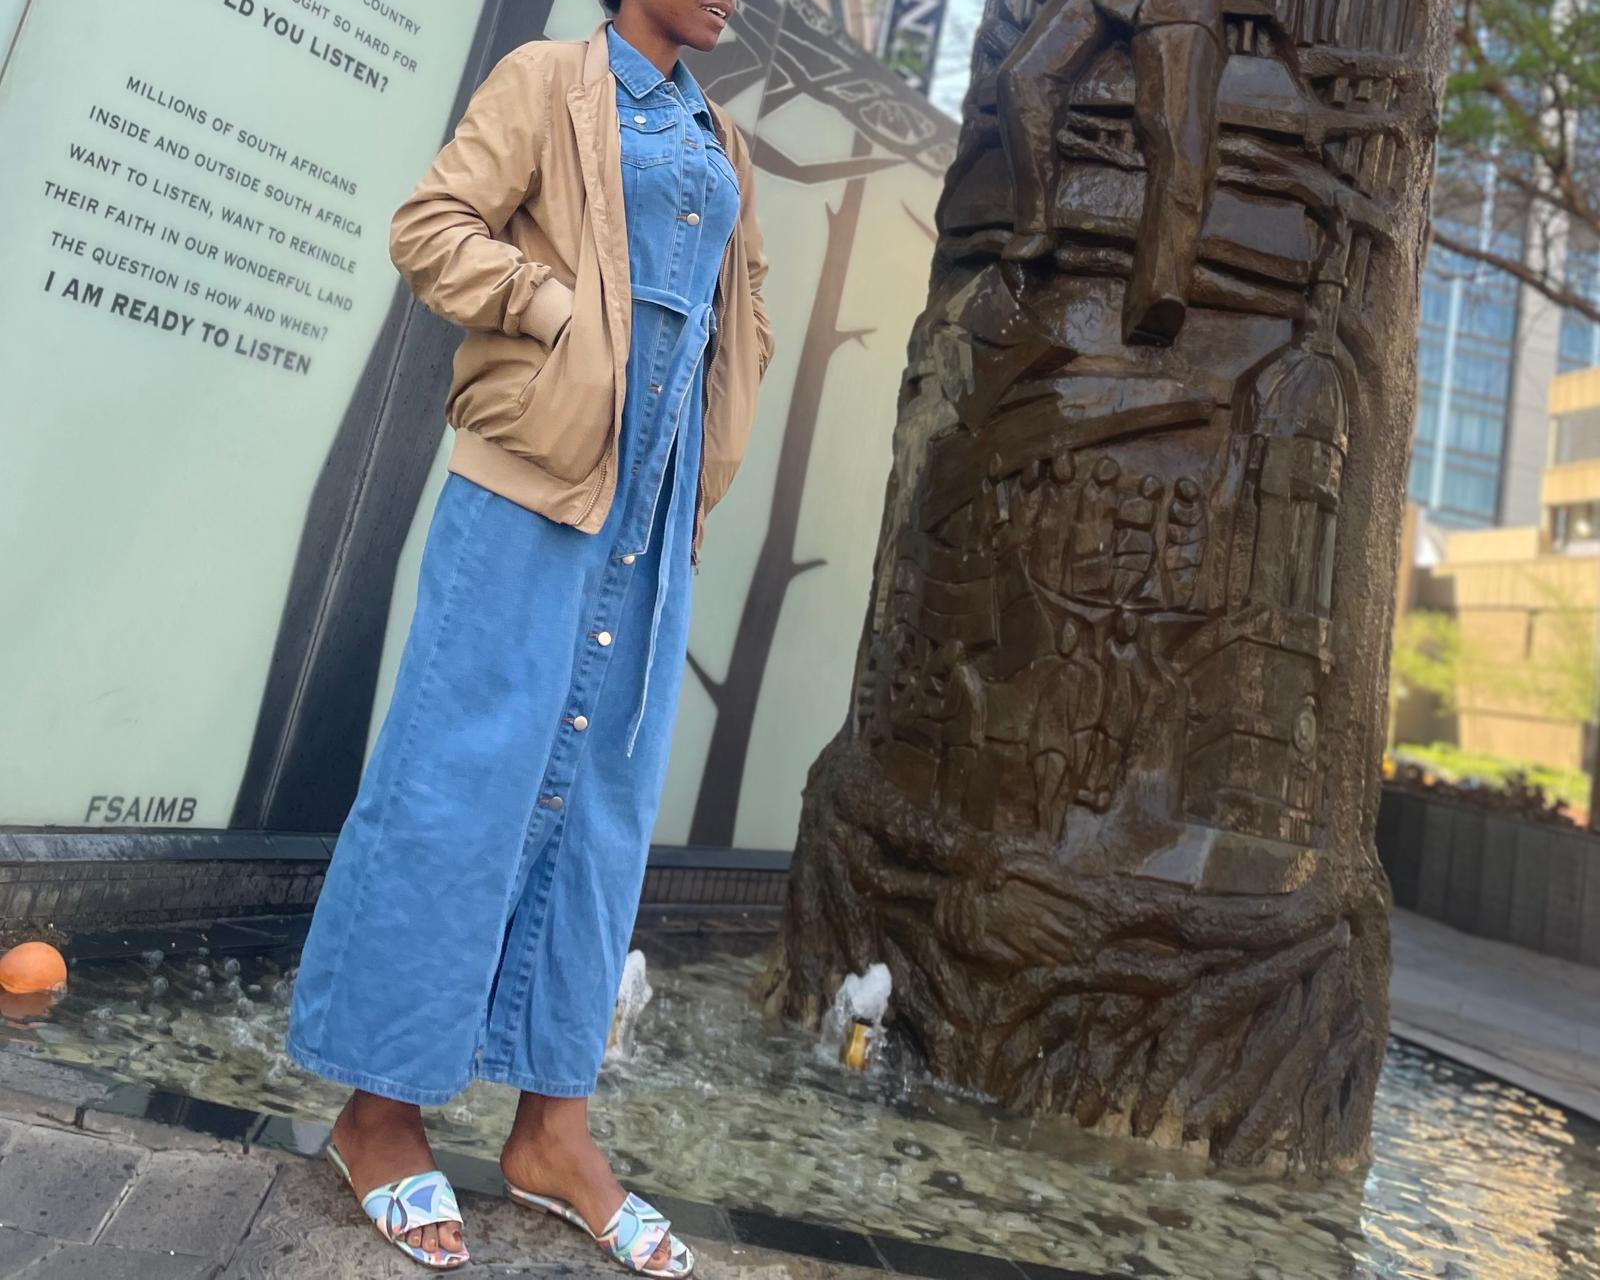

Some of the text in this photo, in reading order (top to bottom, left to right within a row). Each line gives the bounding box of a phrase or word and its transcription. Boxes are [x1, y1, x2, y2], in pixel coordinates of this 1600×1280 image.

[262, 7, 304, 44] YOU
[309, 36, 389, 93] LISTEN?
[332, 14, 351, 33] SO
[354, 28, 390, 56] HARD
[392, 50, 418, 72] FOR
[89, 105, 363, 238] INSIDE AND OUTSIDE SOUTH AFRICA
[126, 76, 358, 196] MILLIONS OF SOUTH AFRICANS
[44, 181, 353, 311] THEIR FAITH IN OUR WONDERFUL LAND
[69, 143, 357, 273] WANT TO LISTEN, WANT TO REKINDLE
[44, 270, 312, 376] I AM READY TO LISTEN
[51, 231, 329, 342] THE QUESTION IS HOW AND WHEN?
[83, 794, 198, 823] FSAIMB
